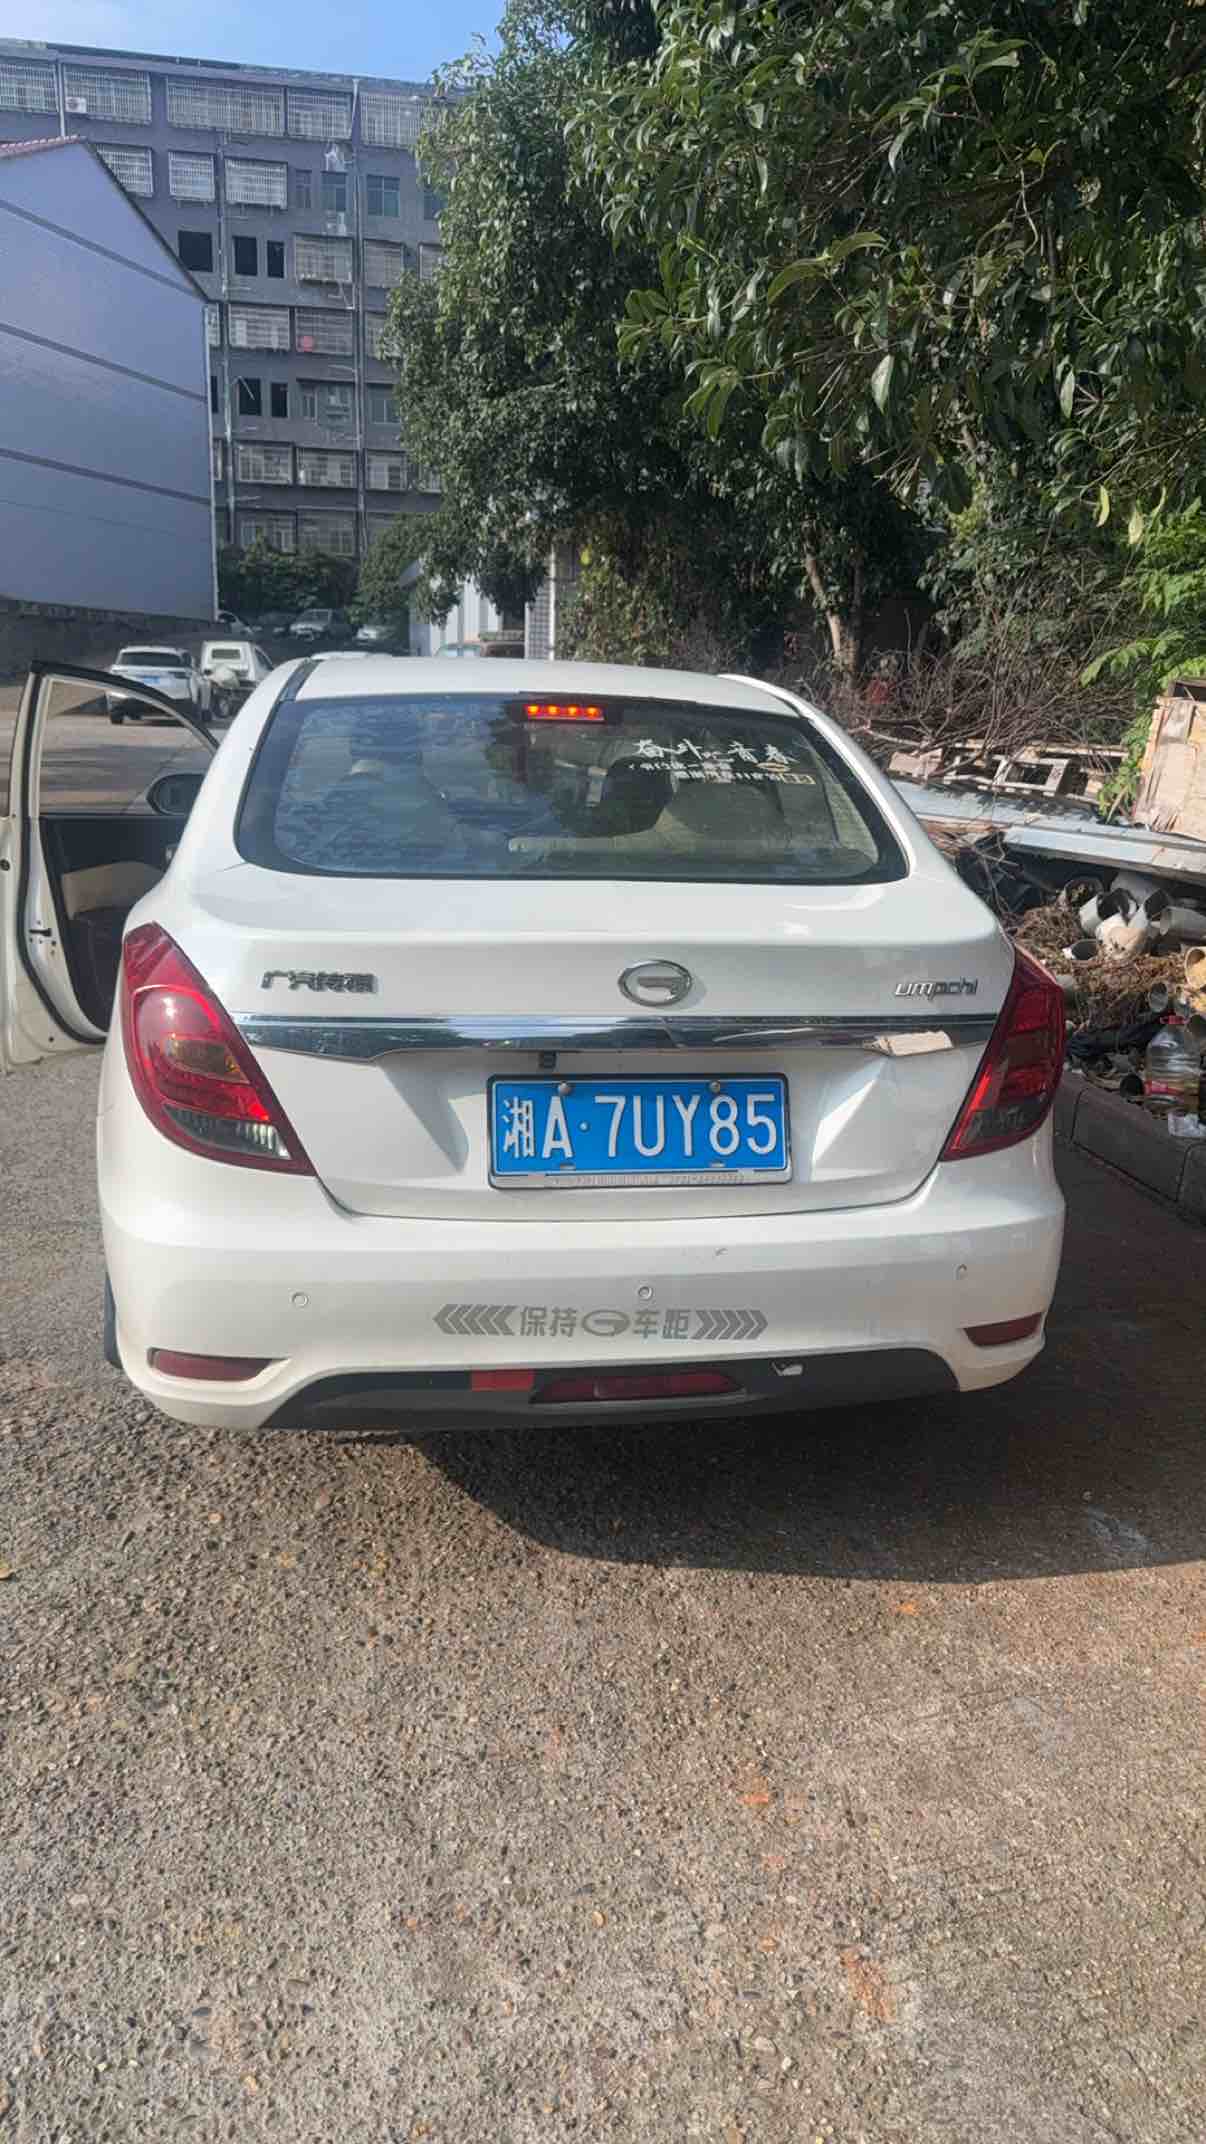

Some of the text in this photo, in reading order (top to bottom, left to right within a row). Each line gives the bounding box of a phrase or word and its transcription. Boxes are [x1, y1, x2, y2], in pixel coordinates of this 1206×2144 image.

[501, 1094, 778, 1159] 湘A·7UY85
[519, 1305, 692, 1340] 保持 车距
